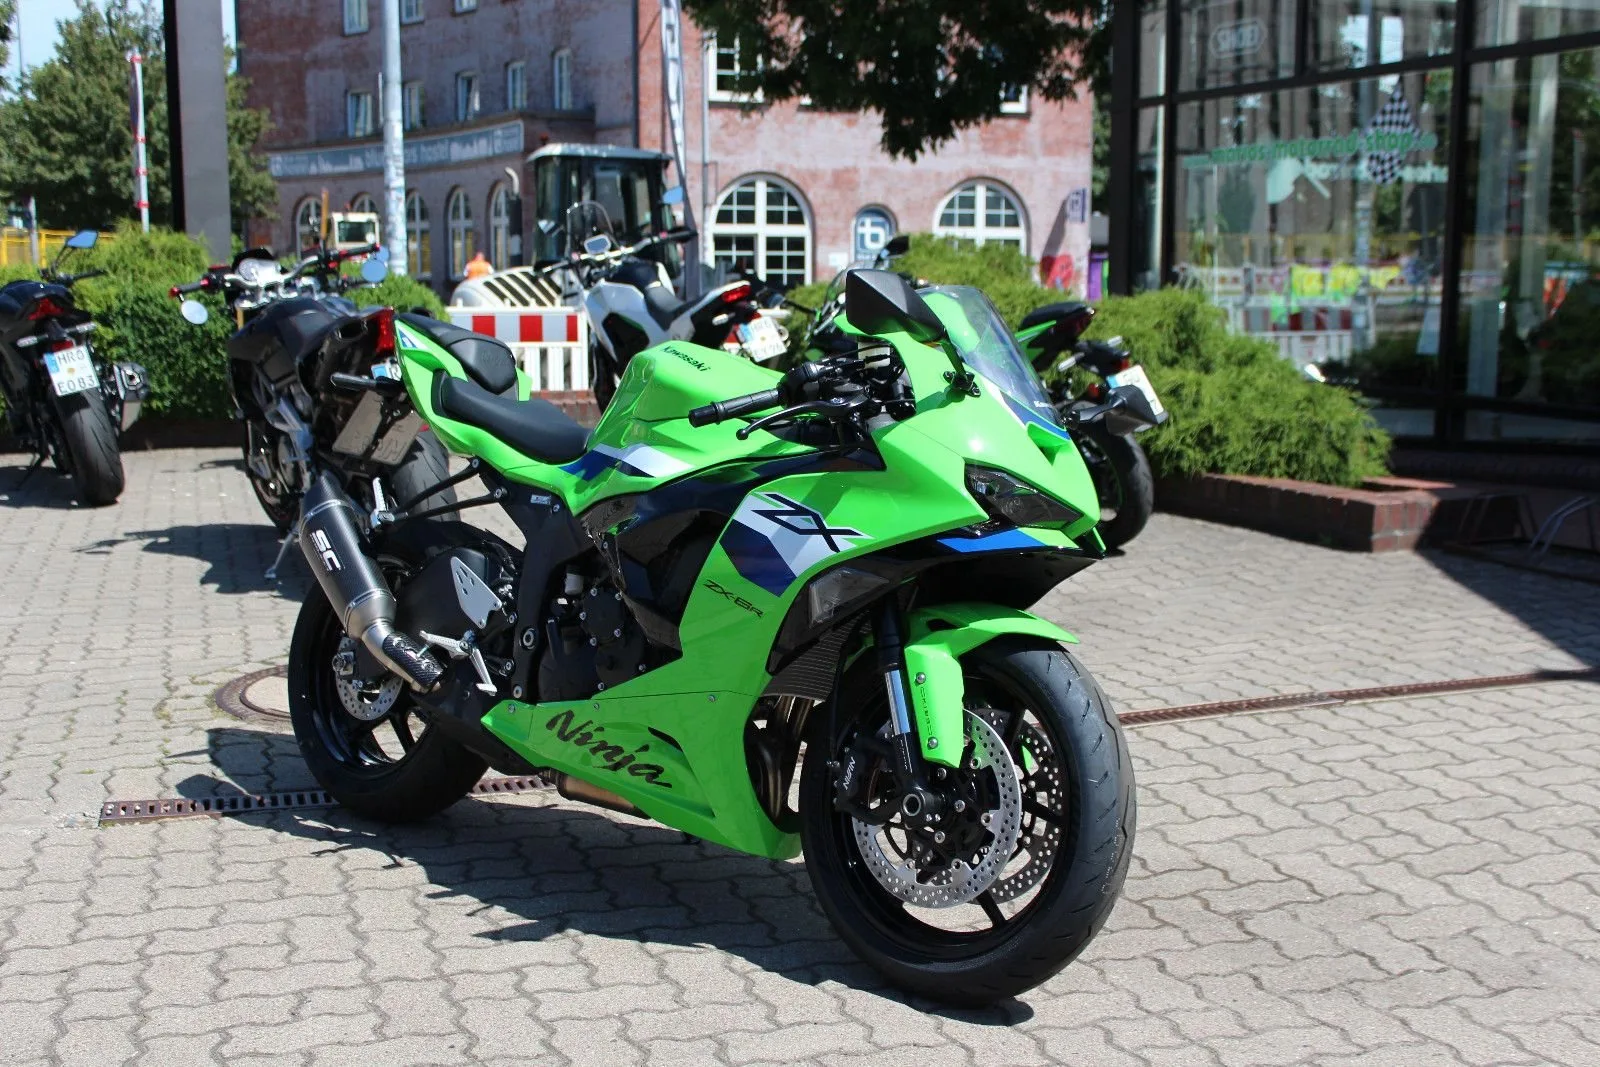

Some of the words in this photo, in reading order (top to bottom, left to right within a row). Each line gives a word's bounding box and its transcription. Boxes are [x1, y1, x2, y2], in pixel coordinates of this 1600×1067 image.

[663, 345, 711, 371] Kawasaki
[703, 579, 765, 618] ZX-6R
[545, 709, 673, 788] Ninja
